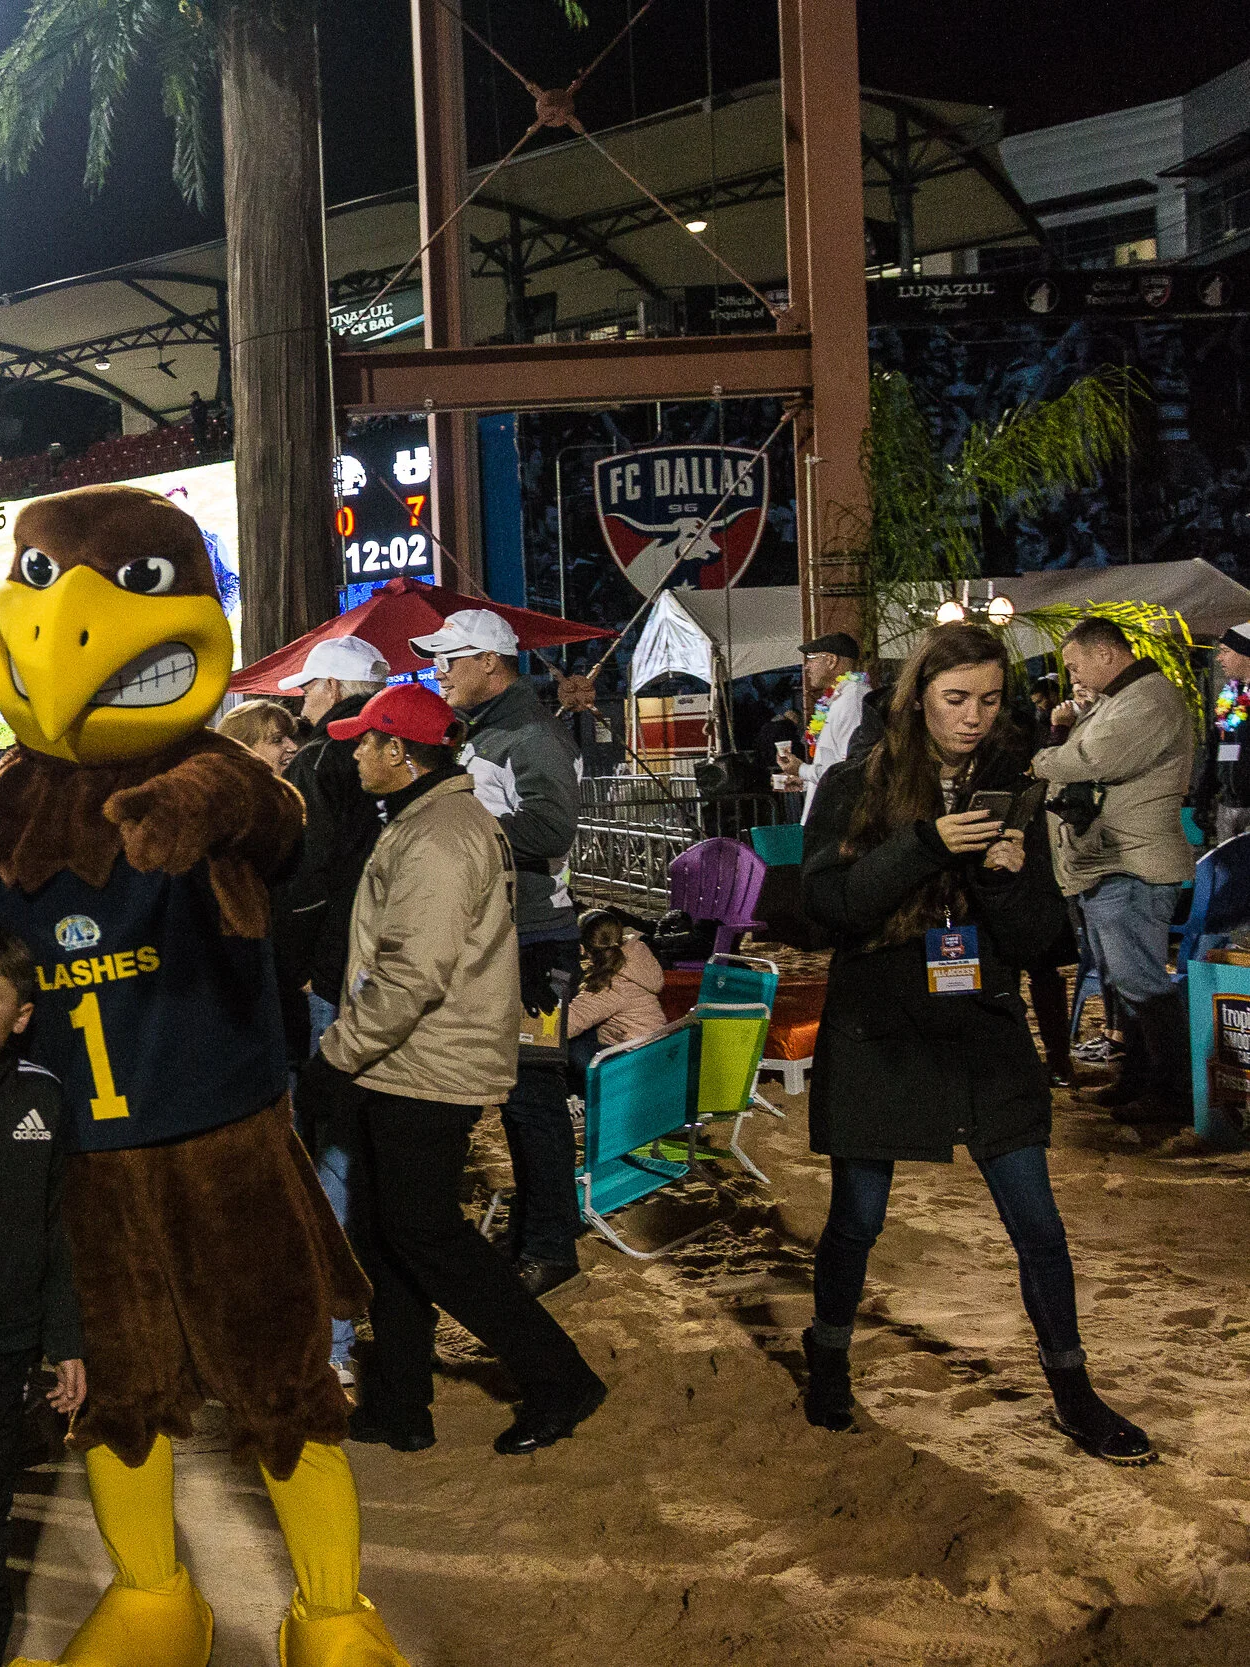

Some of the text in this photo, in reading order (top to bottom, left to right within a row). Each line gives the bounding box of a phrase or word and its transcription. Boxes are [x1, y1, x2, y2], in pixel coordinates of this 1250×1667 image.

[898, 283, 996, 298] LUNAZUL
[369, 316, 394, 331] BAR
[609, 456, 754, 505] FC DALLAS
[406, 495, 426, 527] 7
[667, 502, 699, 514] 96
[345, 534, 428, 574] 12:02
[34, 945, 161, 991] LASHES
[68, 991, 130, 1121] 1
[12, 1129, 52, 1141] adidas
